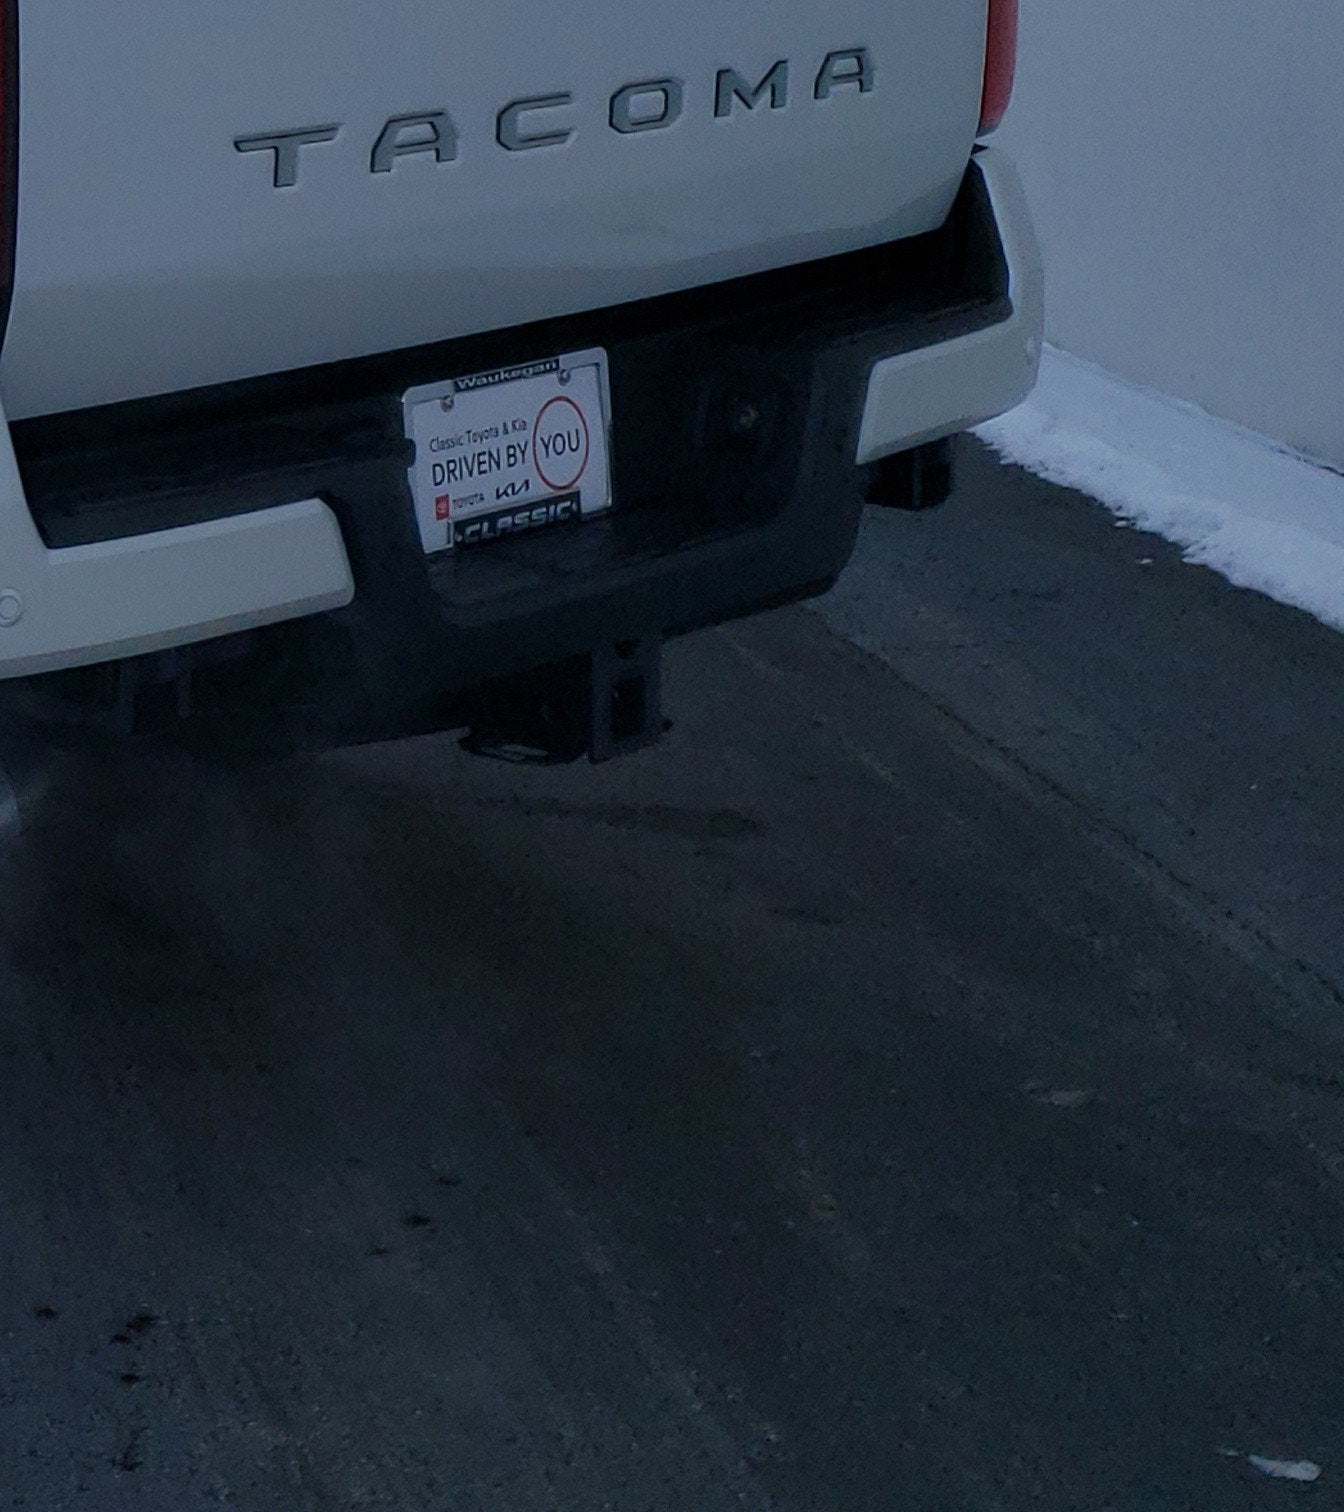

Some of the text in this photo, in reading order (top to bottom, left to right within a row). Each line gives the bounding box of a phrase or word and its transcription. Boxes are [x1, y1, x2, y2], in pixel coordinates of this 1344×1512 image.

[233, 46, 875, 188] TACOMA
[456, 360, 558, 390] Waukegan
[429, 434, 464, 453] Classic
[466, 424, 500, 445] Toyota
[511, 418, 528, 433] Kia
[432, 428, 581, 487] DRIVEN BY YOU
[463, 500, 573, 544] CLASSIC
